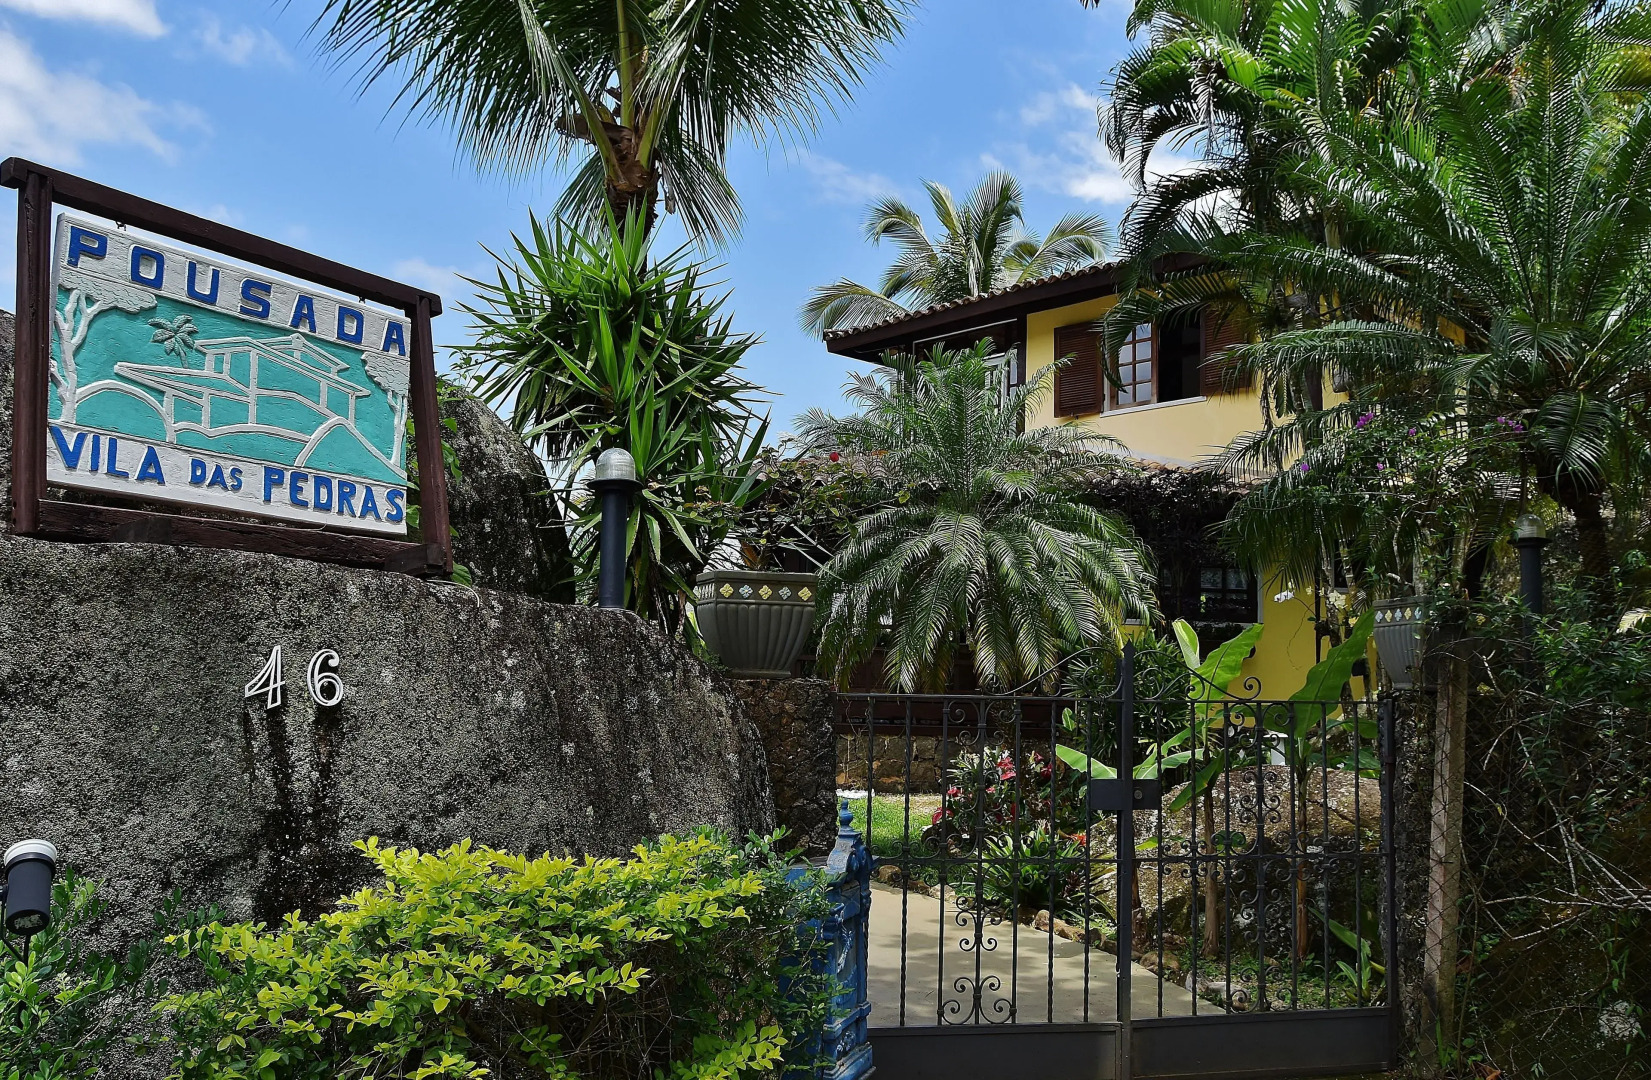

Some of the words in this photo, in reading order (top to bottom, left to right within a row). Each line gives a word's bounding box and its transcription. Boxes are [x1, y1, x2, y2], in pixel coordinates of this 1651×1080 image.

[67, 225, 406, 357] POUSADA
[49, 425, 166, 485] VILA
[189, 457, 243, 492] DAS
[262, 465, 405, 523] PEDRAS
[244, 644, 344, 710] 46
